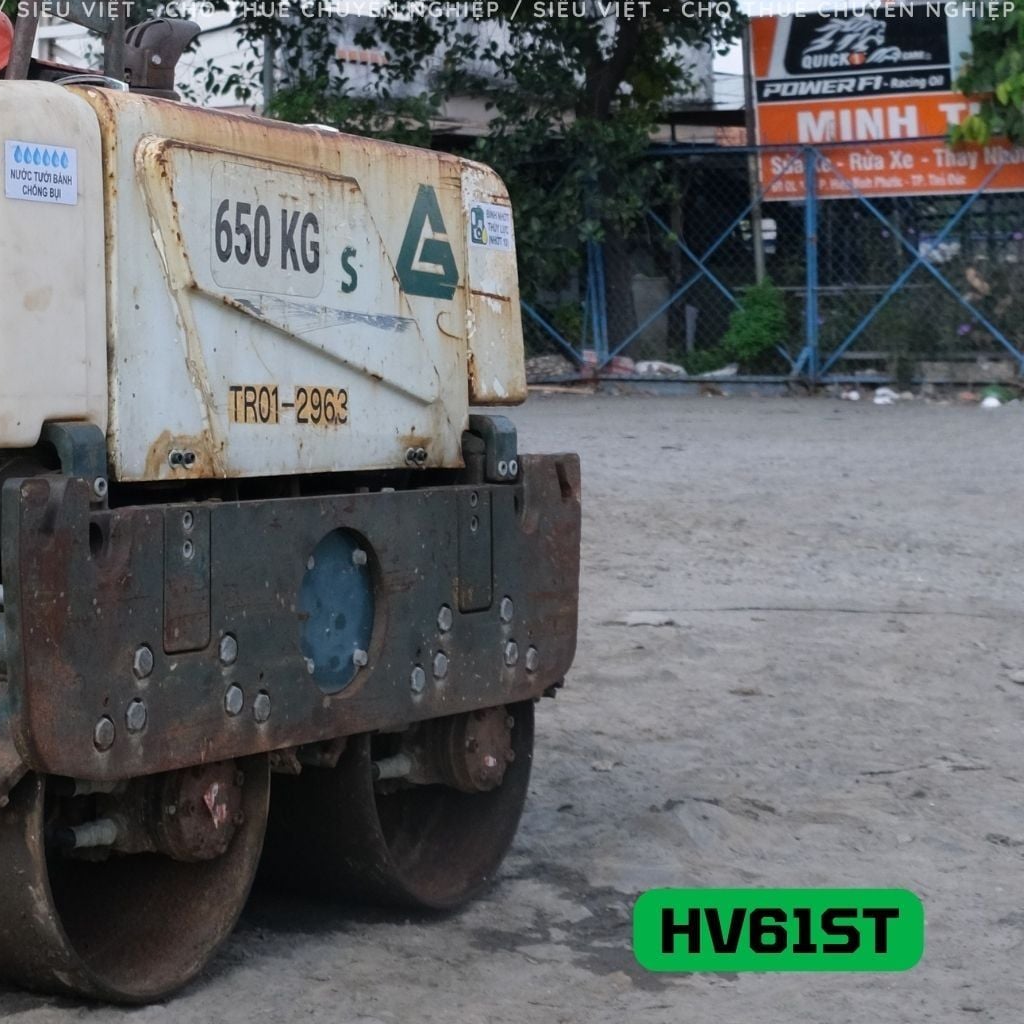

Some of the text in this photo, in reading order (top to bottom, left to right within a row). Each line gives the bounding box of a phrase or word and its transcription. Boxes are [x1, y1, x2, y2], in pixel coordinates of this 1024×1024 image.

[801, 52, 850, 70] QUICK
[763, 78, 856, 98] POWER
[797, 105, 918, 143] MINH
[890, 150, 914, 170] Xe
[933, 148, 978, 170] Thay
[10, 167, 32, 181] NƯỚC
[215, 198, 320, 274] 650 KG
[229, 385, 348, 424] TR01-2963
